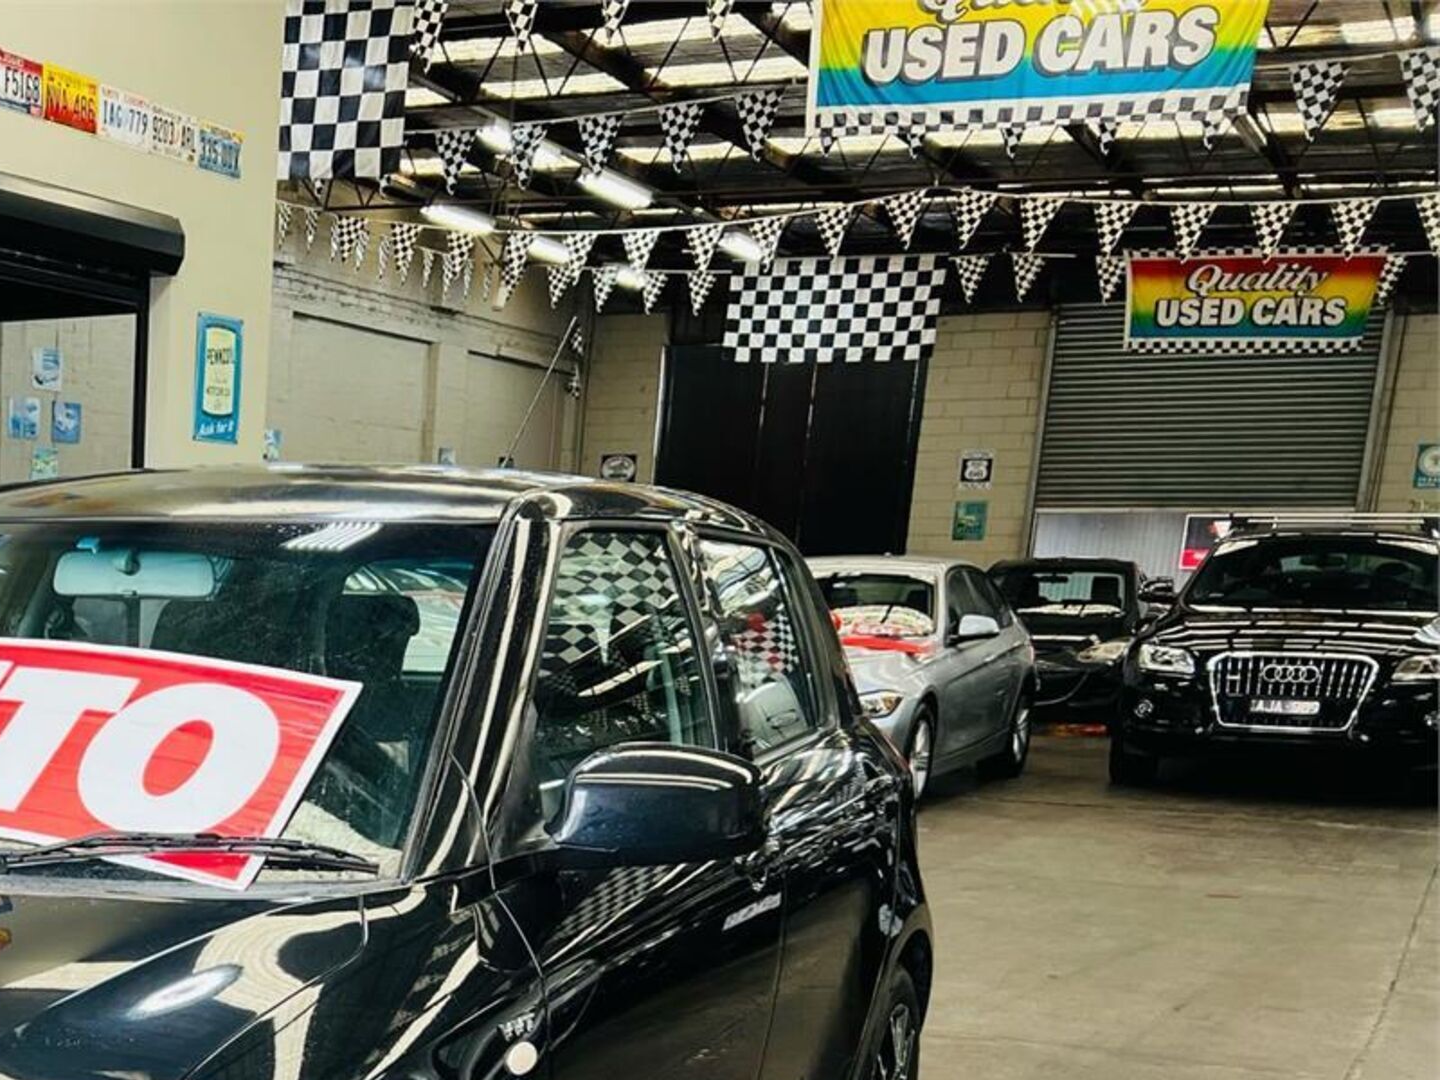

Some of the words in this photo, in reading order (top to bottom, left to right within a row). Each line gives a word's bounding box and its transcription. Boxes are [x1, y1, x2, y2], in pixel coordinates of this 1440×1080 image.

[864, 19, 1026, 84] USED
[1035, 6, 1220, 76] CARS
[1187, 262, 1329, 297] Quality
[1156, 297, 1245, 327] USED
[1252, 297, 1346, 326] CARS
